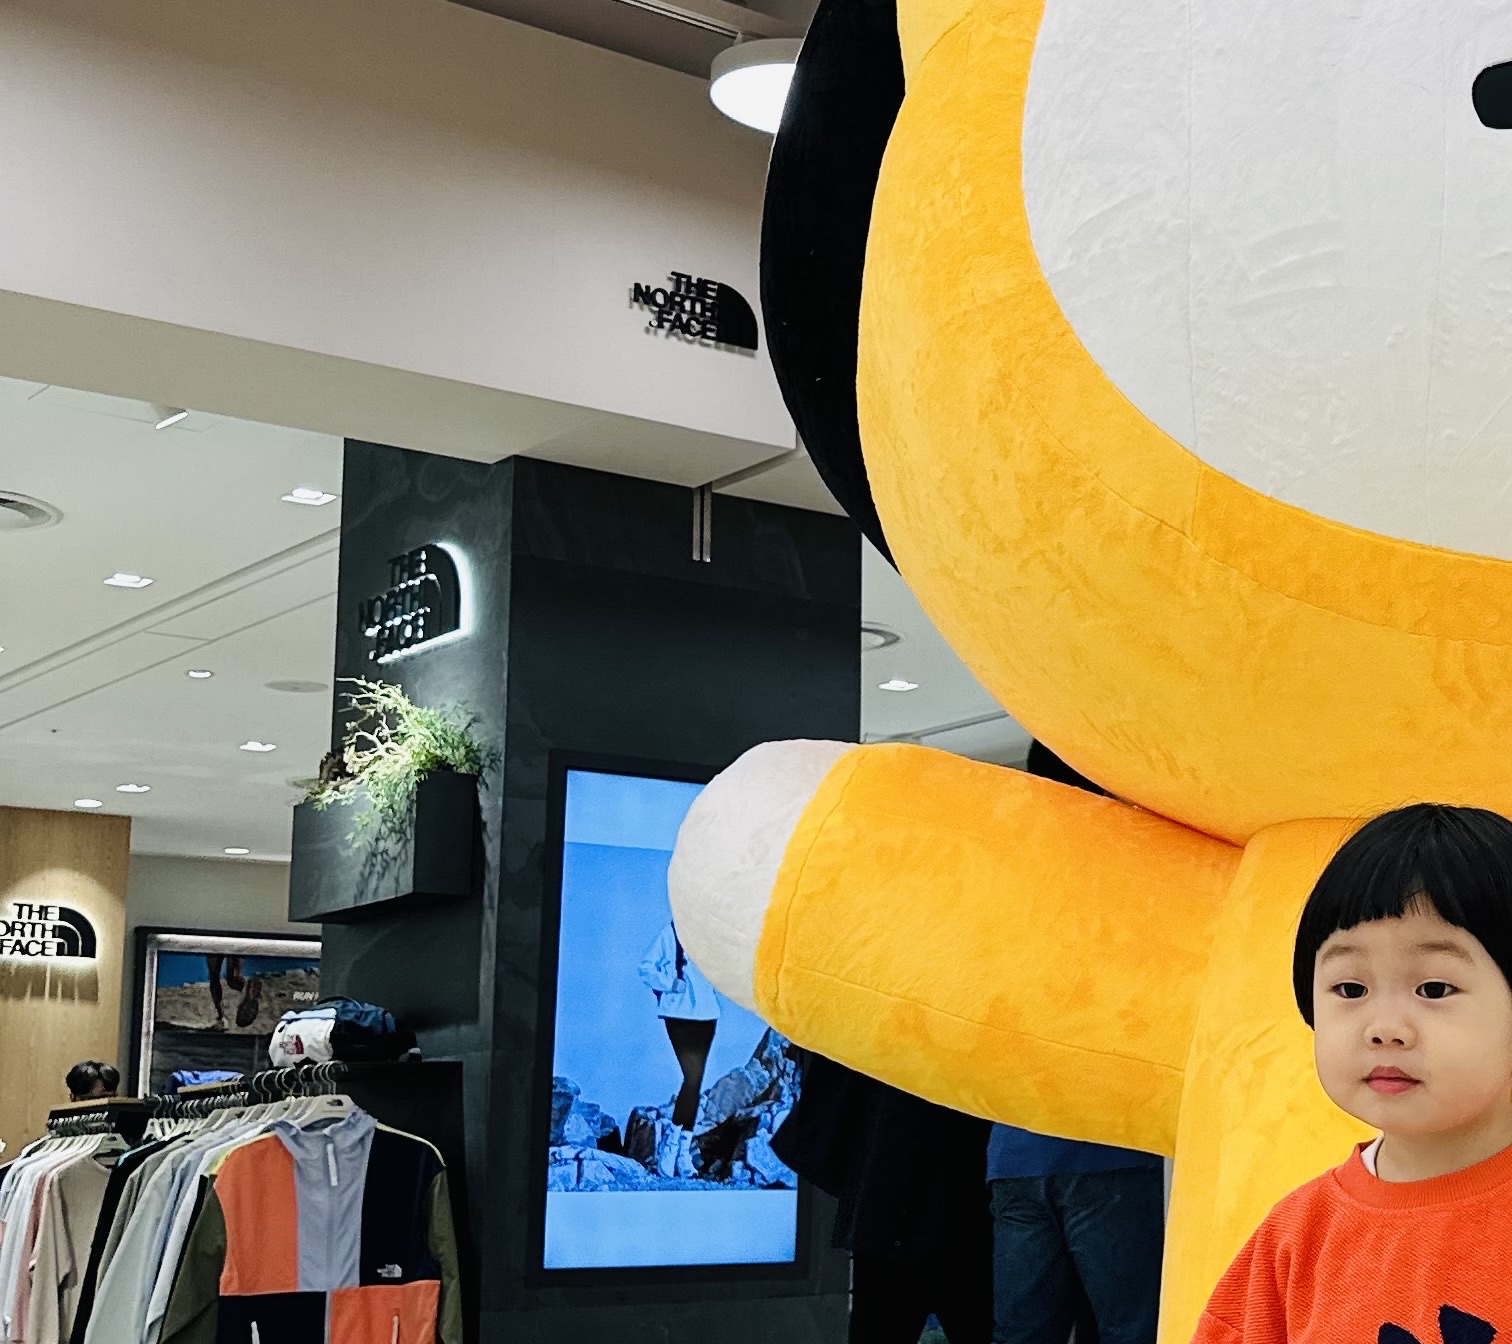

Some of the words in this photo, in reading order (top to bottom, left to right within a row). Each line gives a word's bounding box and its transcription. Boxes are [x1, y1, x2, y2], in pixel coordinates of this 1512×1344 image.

[670, 271, 719, 299] THE
[632, 282, 718, 320] NORTH
[656, 309, 718, 340] FACE
[387, 546, 425, 588] THE
[358, 577, 422, 635] NORTH
[375, 613, 424, 661] FACE
[13, 902, 60, 921] THE
[0, 920, 57, 939] ORTH
[0, 939, 57, 957] FACE
